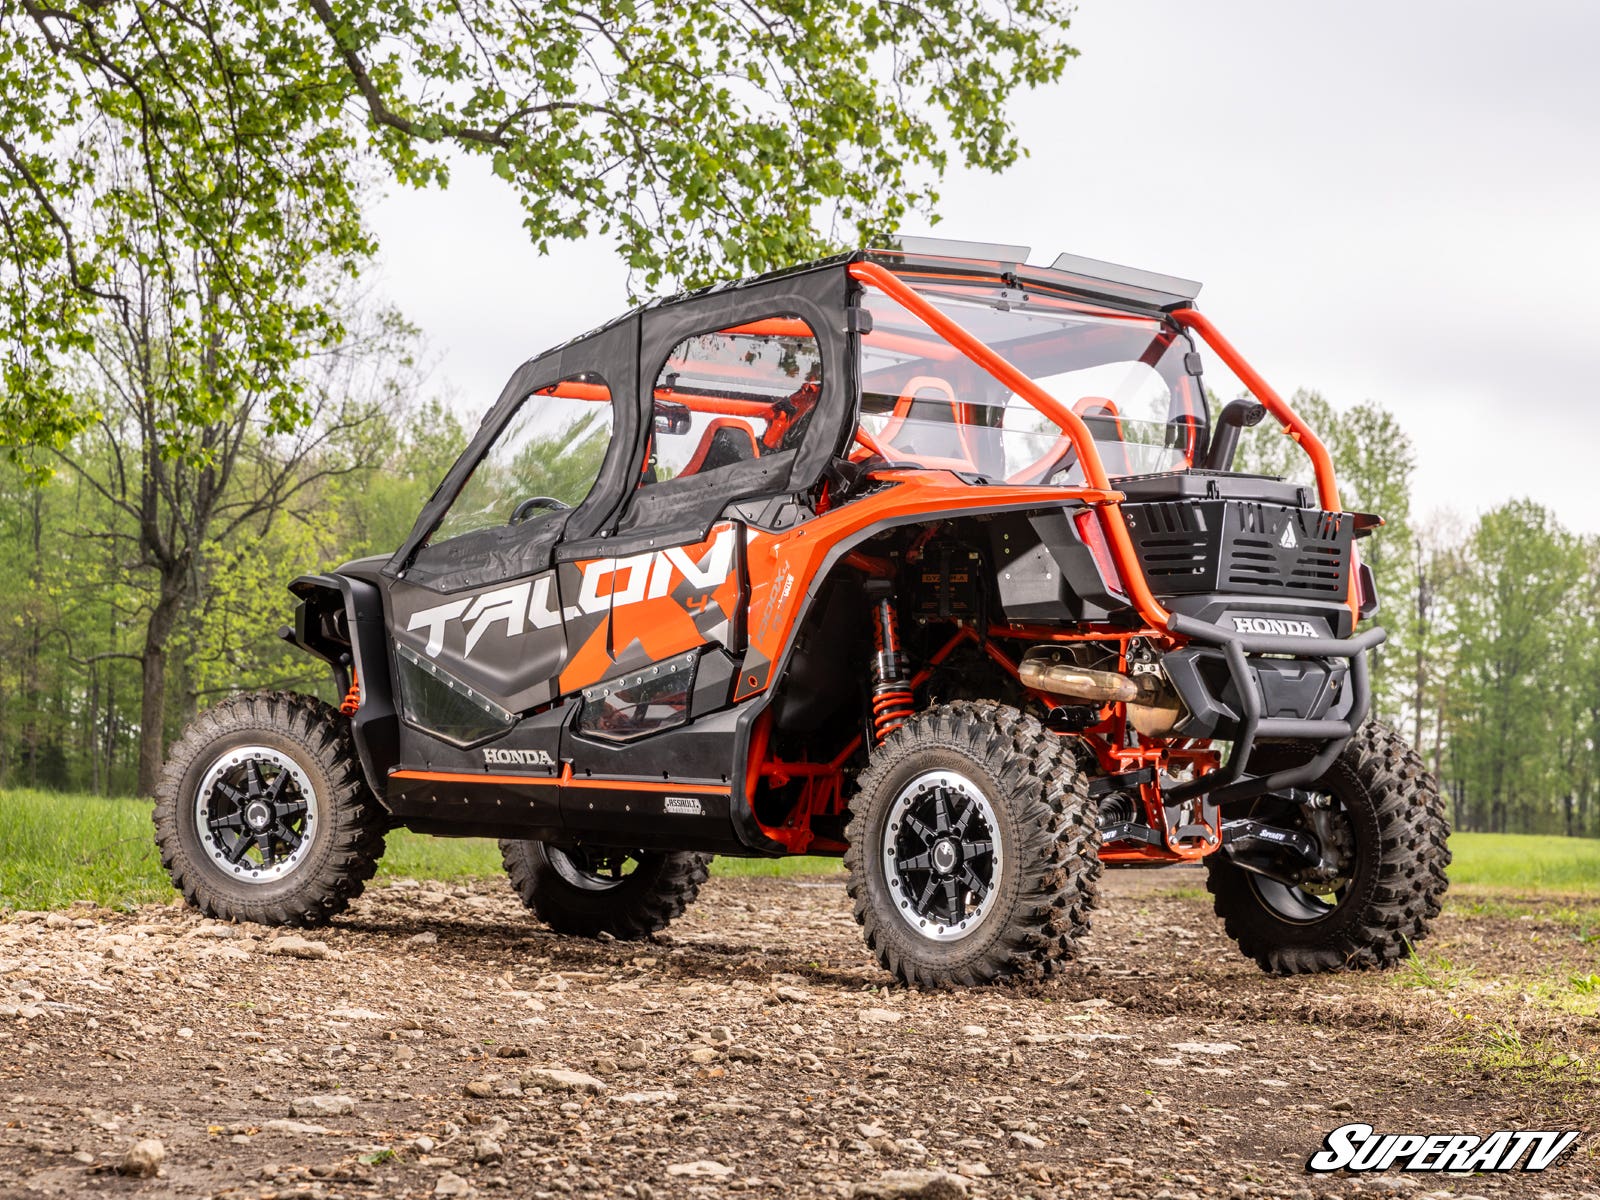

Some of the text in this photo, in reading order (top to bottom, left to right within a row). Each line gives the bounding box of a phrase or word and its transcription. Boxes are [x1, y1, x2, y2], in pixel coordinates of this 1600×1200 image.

[406, 527, 736, 660] TALON
[686, 594, 708, 613] 4
[1231, 617, 1320, 638] HONDA
[482, 747, 556, 766] HONDA
